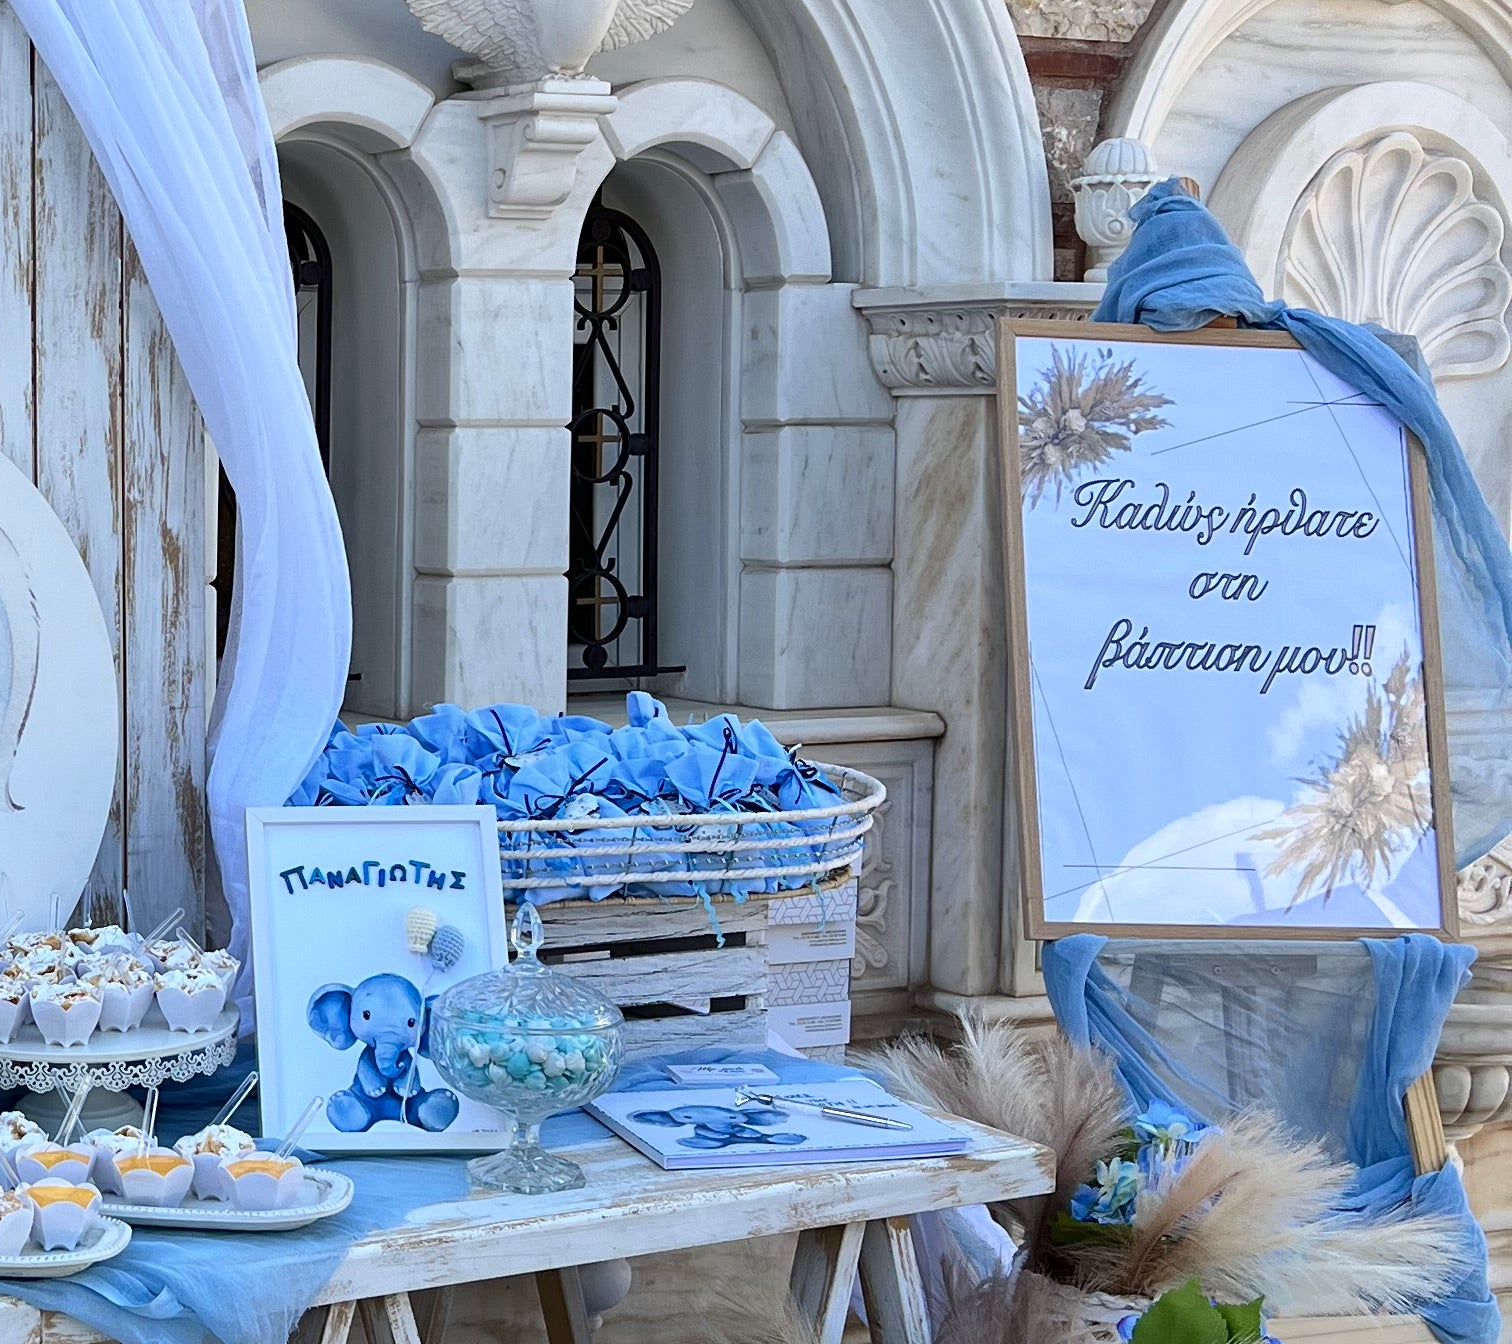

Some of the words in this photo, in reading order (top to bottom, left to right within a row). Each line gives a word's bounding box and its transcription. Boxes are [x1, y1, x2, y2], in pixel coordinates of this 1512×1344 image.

[1071, 478, 1230, 546] Καλώς
[1229, 487, 1380, 556] ήρθατε
[1189, 571, 1269, 601] στη
[1083, 618, 1272, 690] βάπτιση
[1259, 624, 1376, 694] μου!!
[279, 859, 467, 895] ΠΑΝΑΓΙΩΤΗΣ
